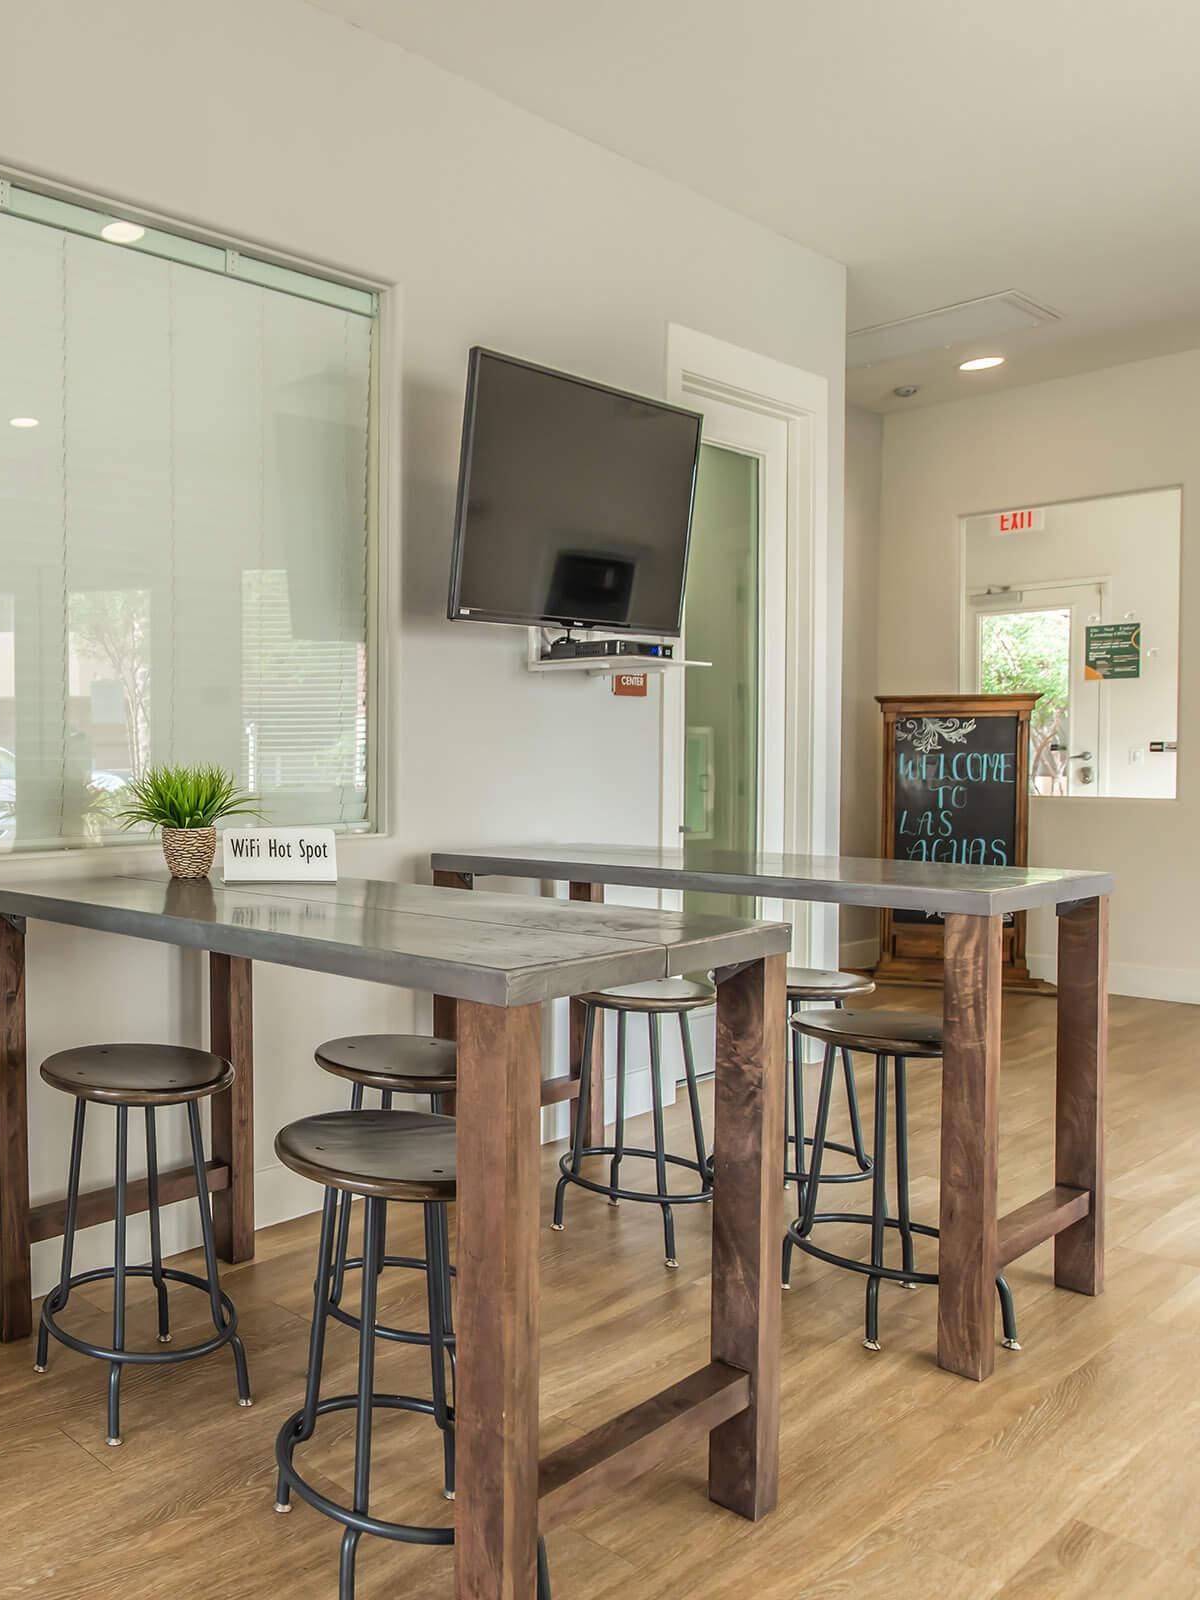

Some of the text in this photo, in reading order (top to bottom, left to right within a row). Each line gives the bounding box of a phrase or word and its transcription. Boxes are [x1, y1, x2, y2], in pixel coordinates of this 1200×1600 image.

[621, 676, 644, 687] CENTER
[899, 752, 1017, 784] WELCOME
[928, 785, 968, 809] TO
[899, 810, 953, 837] LAS
[230, 838, 328, 864] WiFi Hot Spot
[906, 838, 1008, 866] AGUAS
